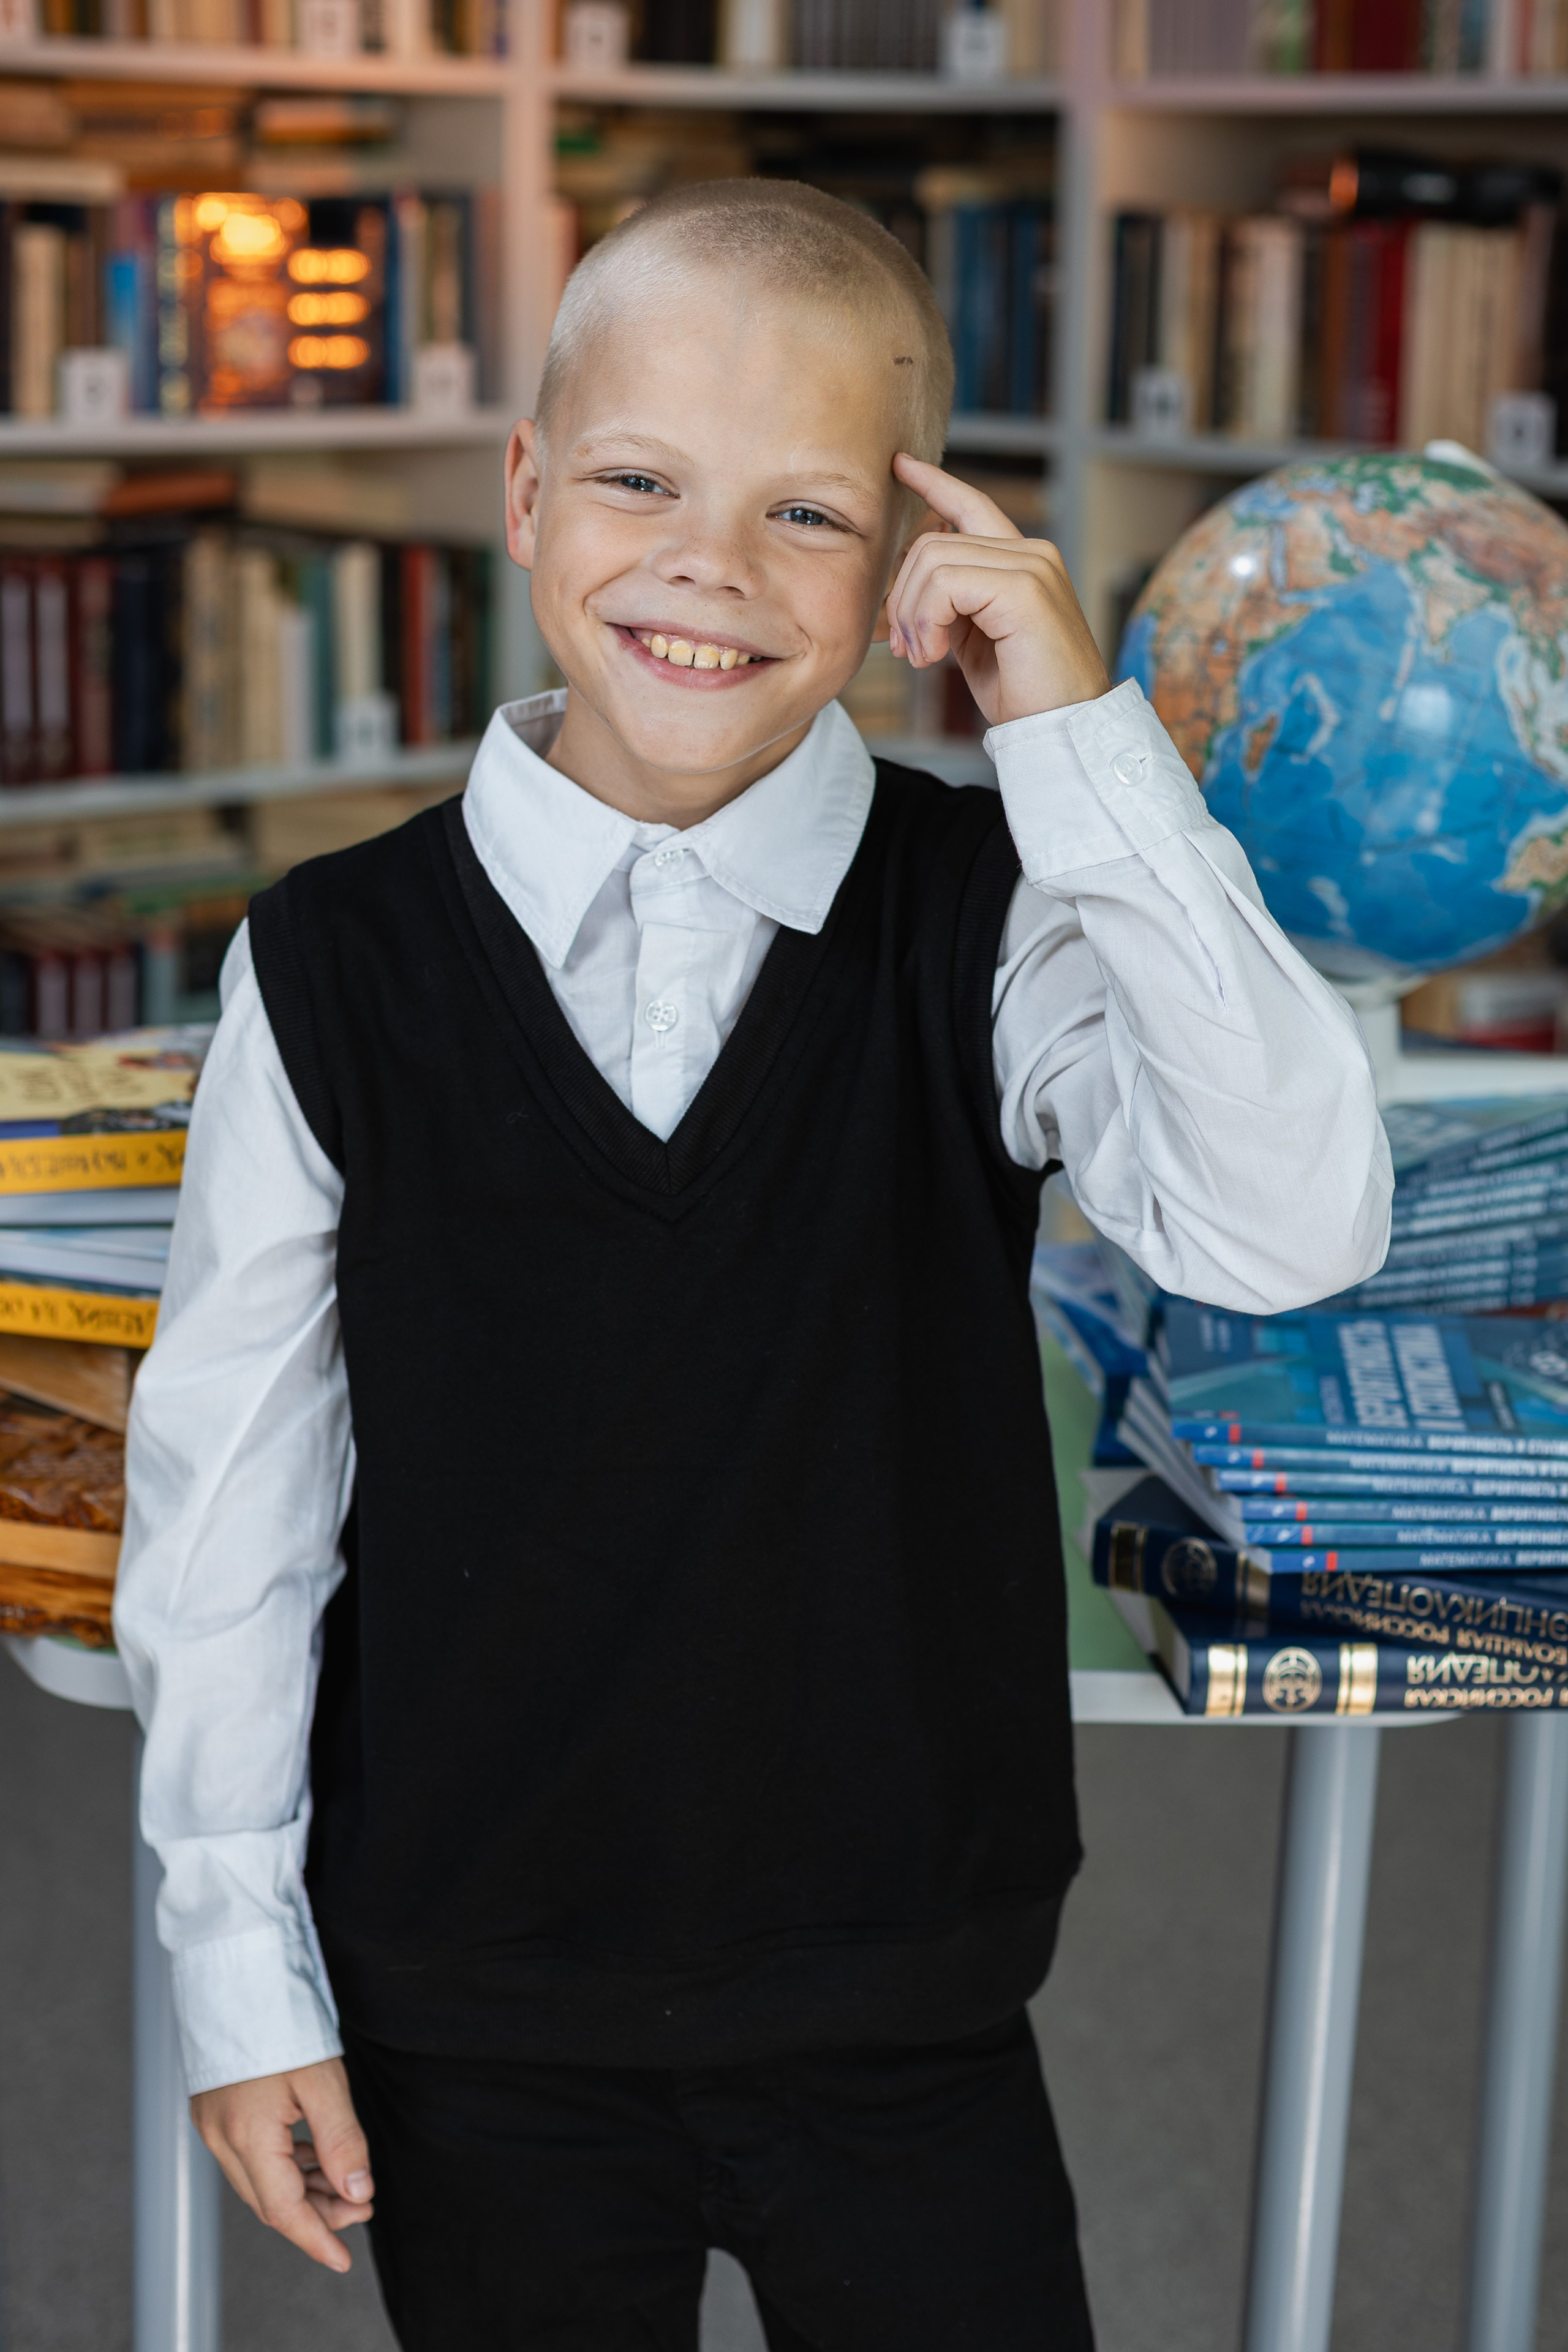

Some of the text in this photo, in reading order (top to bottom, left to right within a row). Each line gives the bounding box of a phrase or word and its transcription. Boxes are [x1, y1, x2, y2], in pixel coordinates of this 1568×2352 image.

[1301, 1569, 1568, 1642] ЭНЦИКЛОПЕДИЯ
[1457, 1627, 1567, 1665] БОЛЬШАЯ
[1404, 1687, 1554, 1709] РОССИЙСКАЯ
